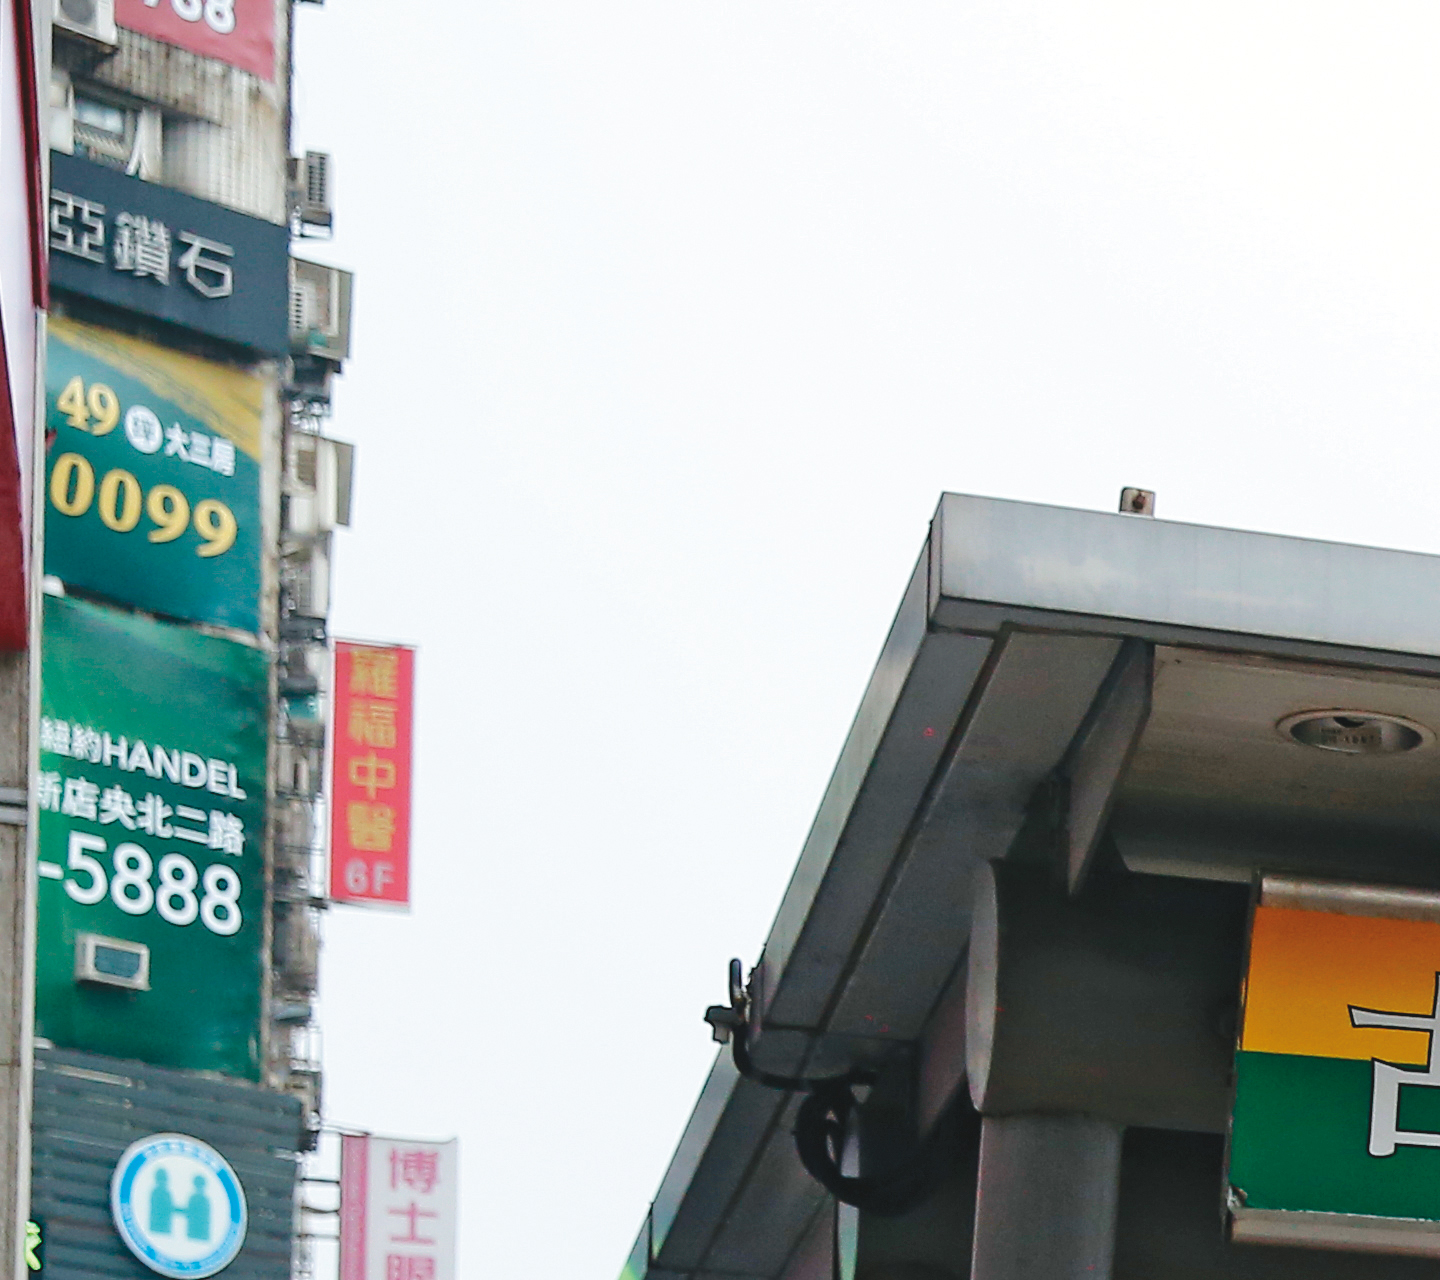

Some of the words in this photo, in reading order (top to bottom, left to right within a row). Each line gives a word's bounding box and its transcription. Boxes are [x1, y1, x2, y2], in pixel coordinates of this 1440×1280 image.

[57, 375, 120, 436] 49
[50, 452, 238, 558] 0099
[344, 857, 394, 895] 6F
